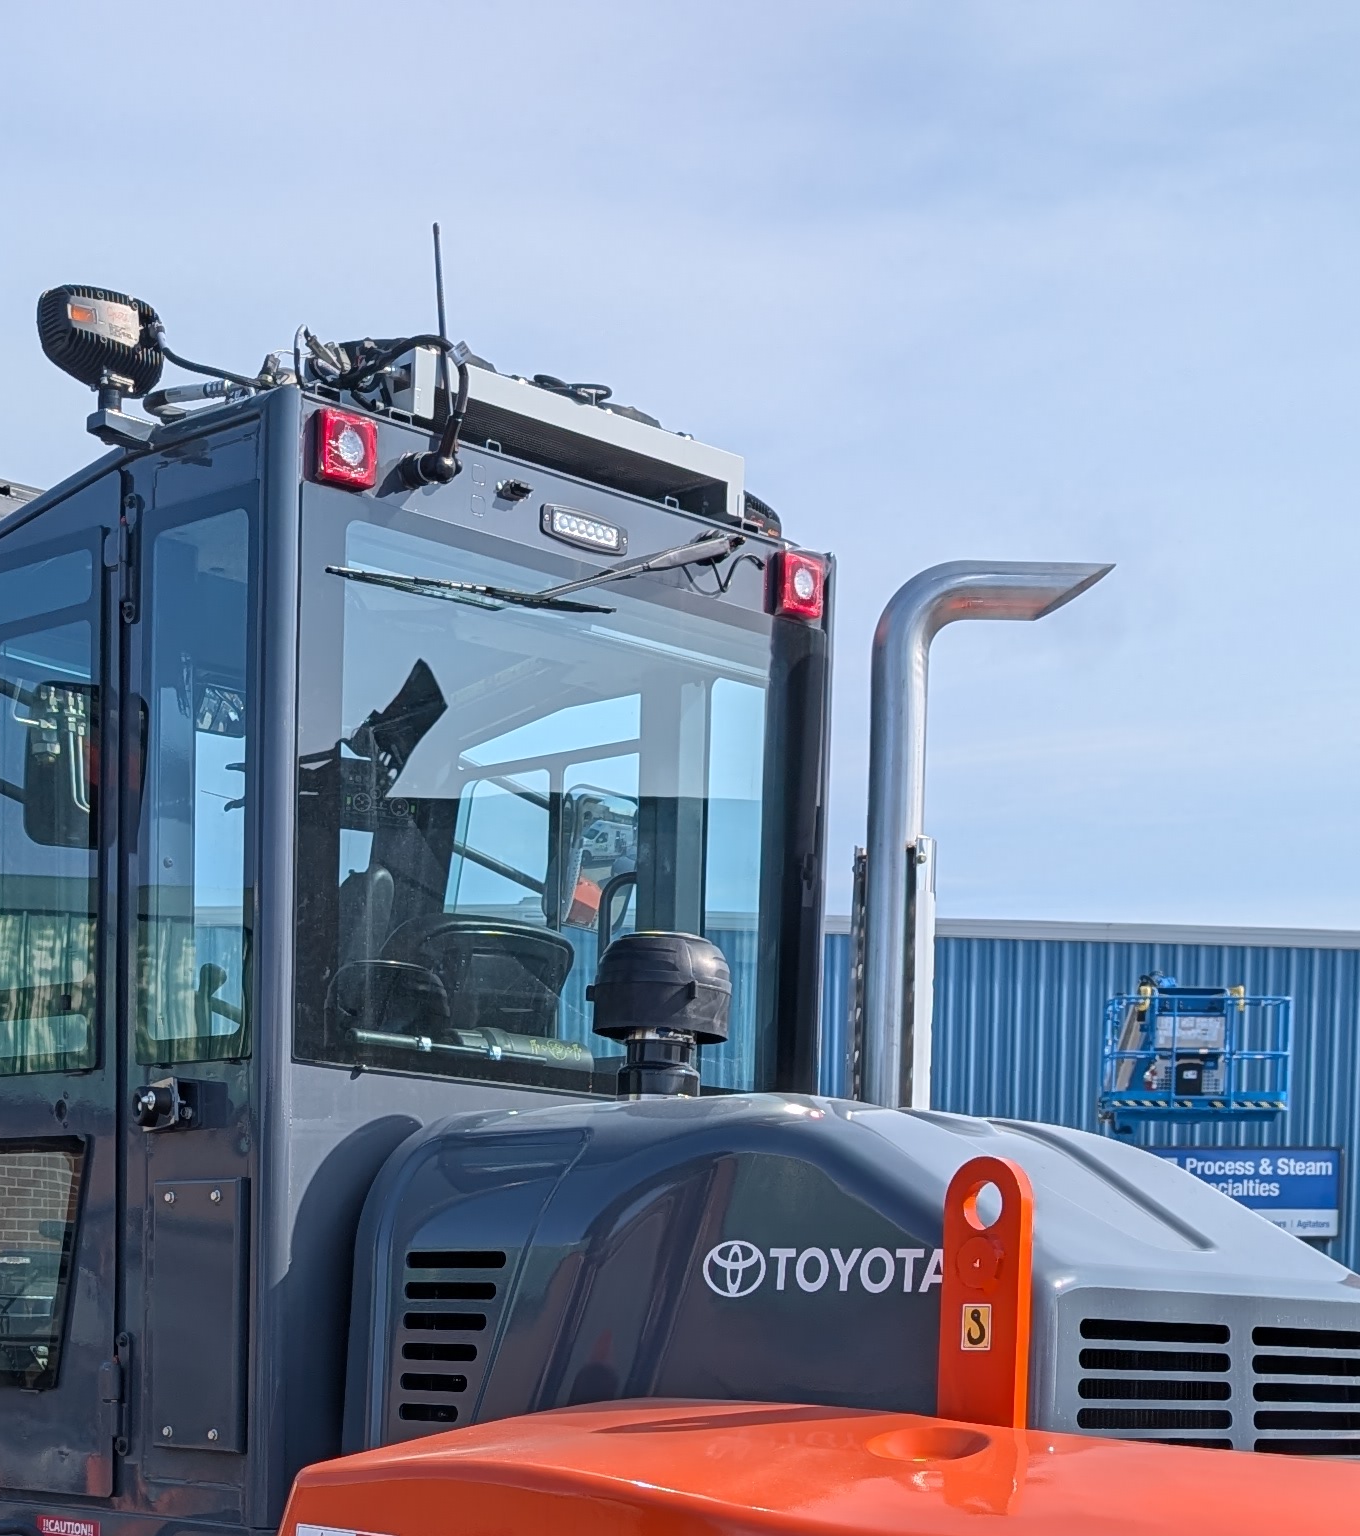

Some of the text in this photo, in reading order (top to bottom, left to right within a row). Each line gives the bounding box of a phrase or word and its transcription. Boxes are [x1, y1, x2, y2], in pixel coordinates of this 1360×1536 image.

[1186, 1157, 1333, 1176] Process & Steam
[1211, 1179, 1280, 1197] cialties
[1296, 1219, 1330, 1230] Agitators
[770, 1247, 944, 1293] TOYOTA
[42, 1518, 94, 1536] !!CAUTION!!
